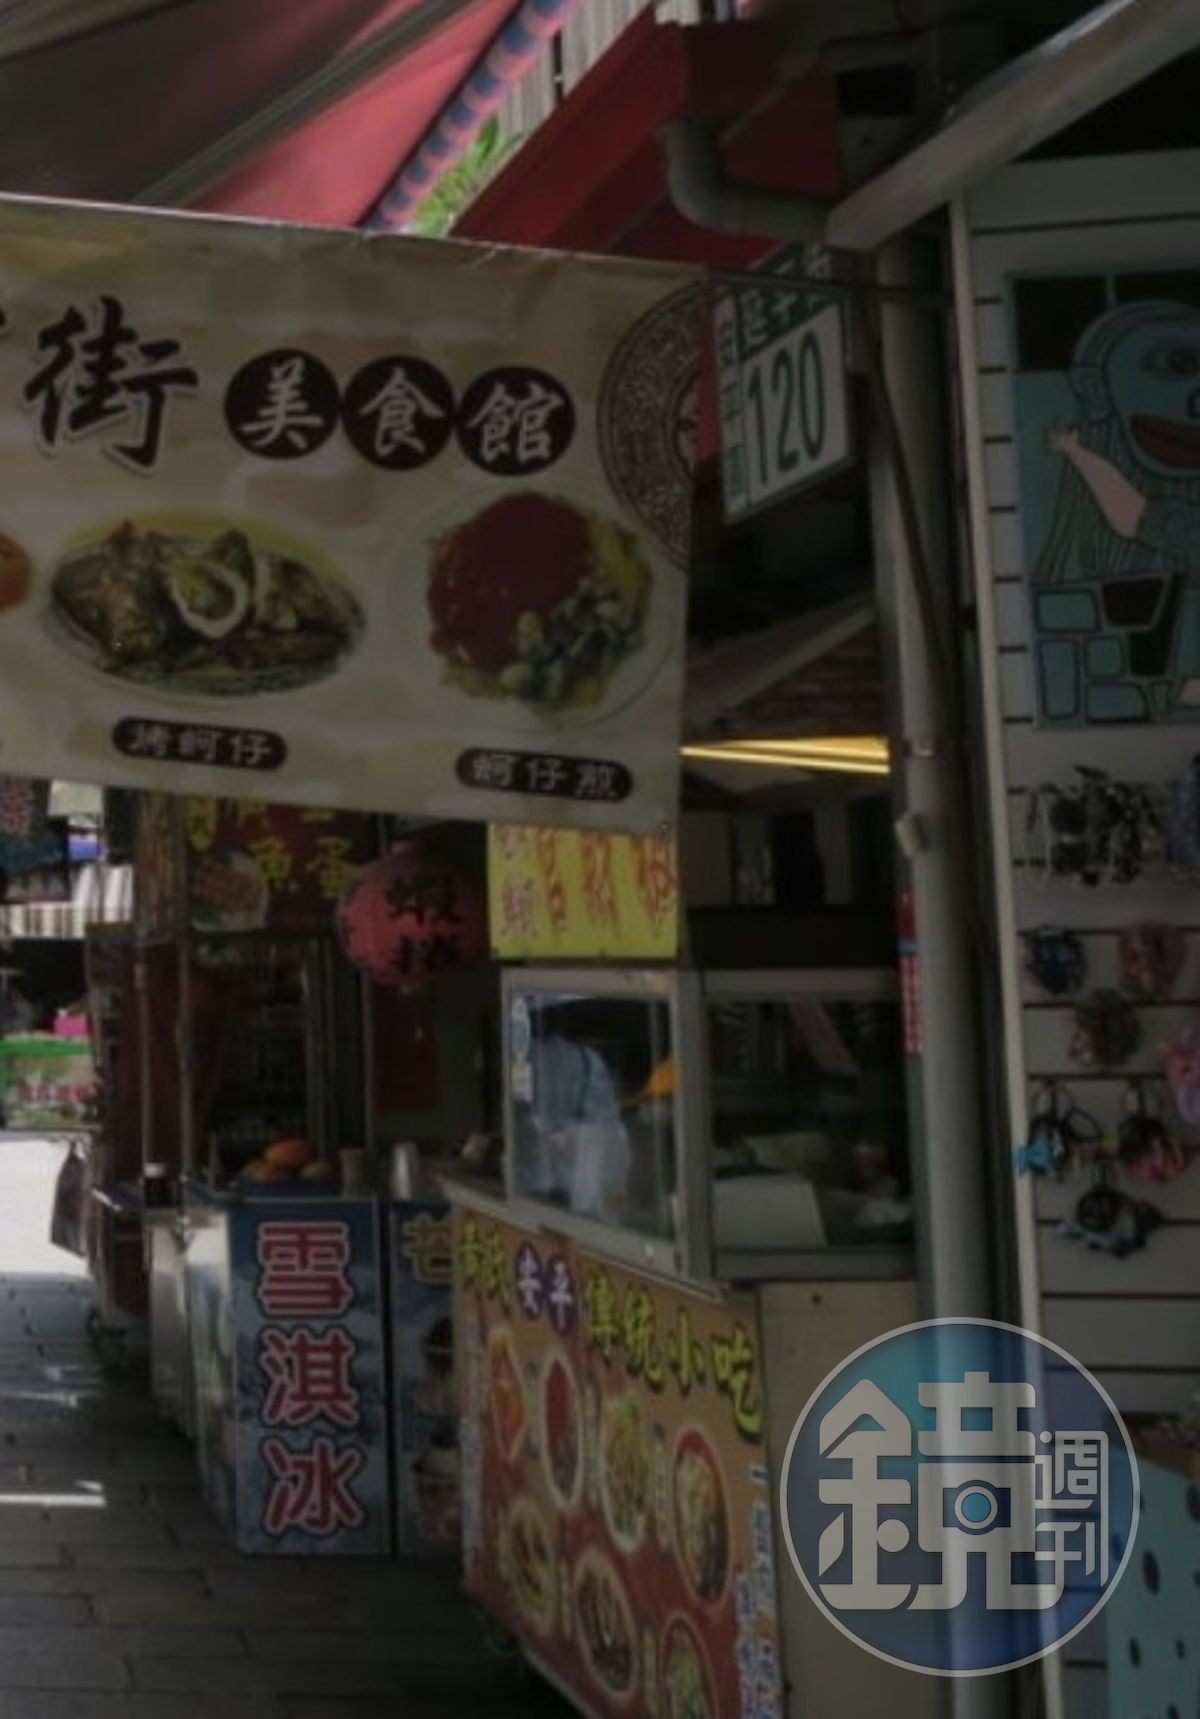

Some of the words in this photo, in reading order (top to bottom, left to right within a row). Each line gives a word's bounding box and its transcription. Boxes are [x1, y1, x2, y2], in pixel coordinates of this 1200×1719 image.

[238, 356, 567, 464] 美食館
[747, 332, 826, 487] 120
[129, 723, 275, 768] 烤蚵仔
[257, 1220, 365, 1536] 雪淇冰
